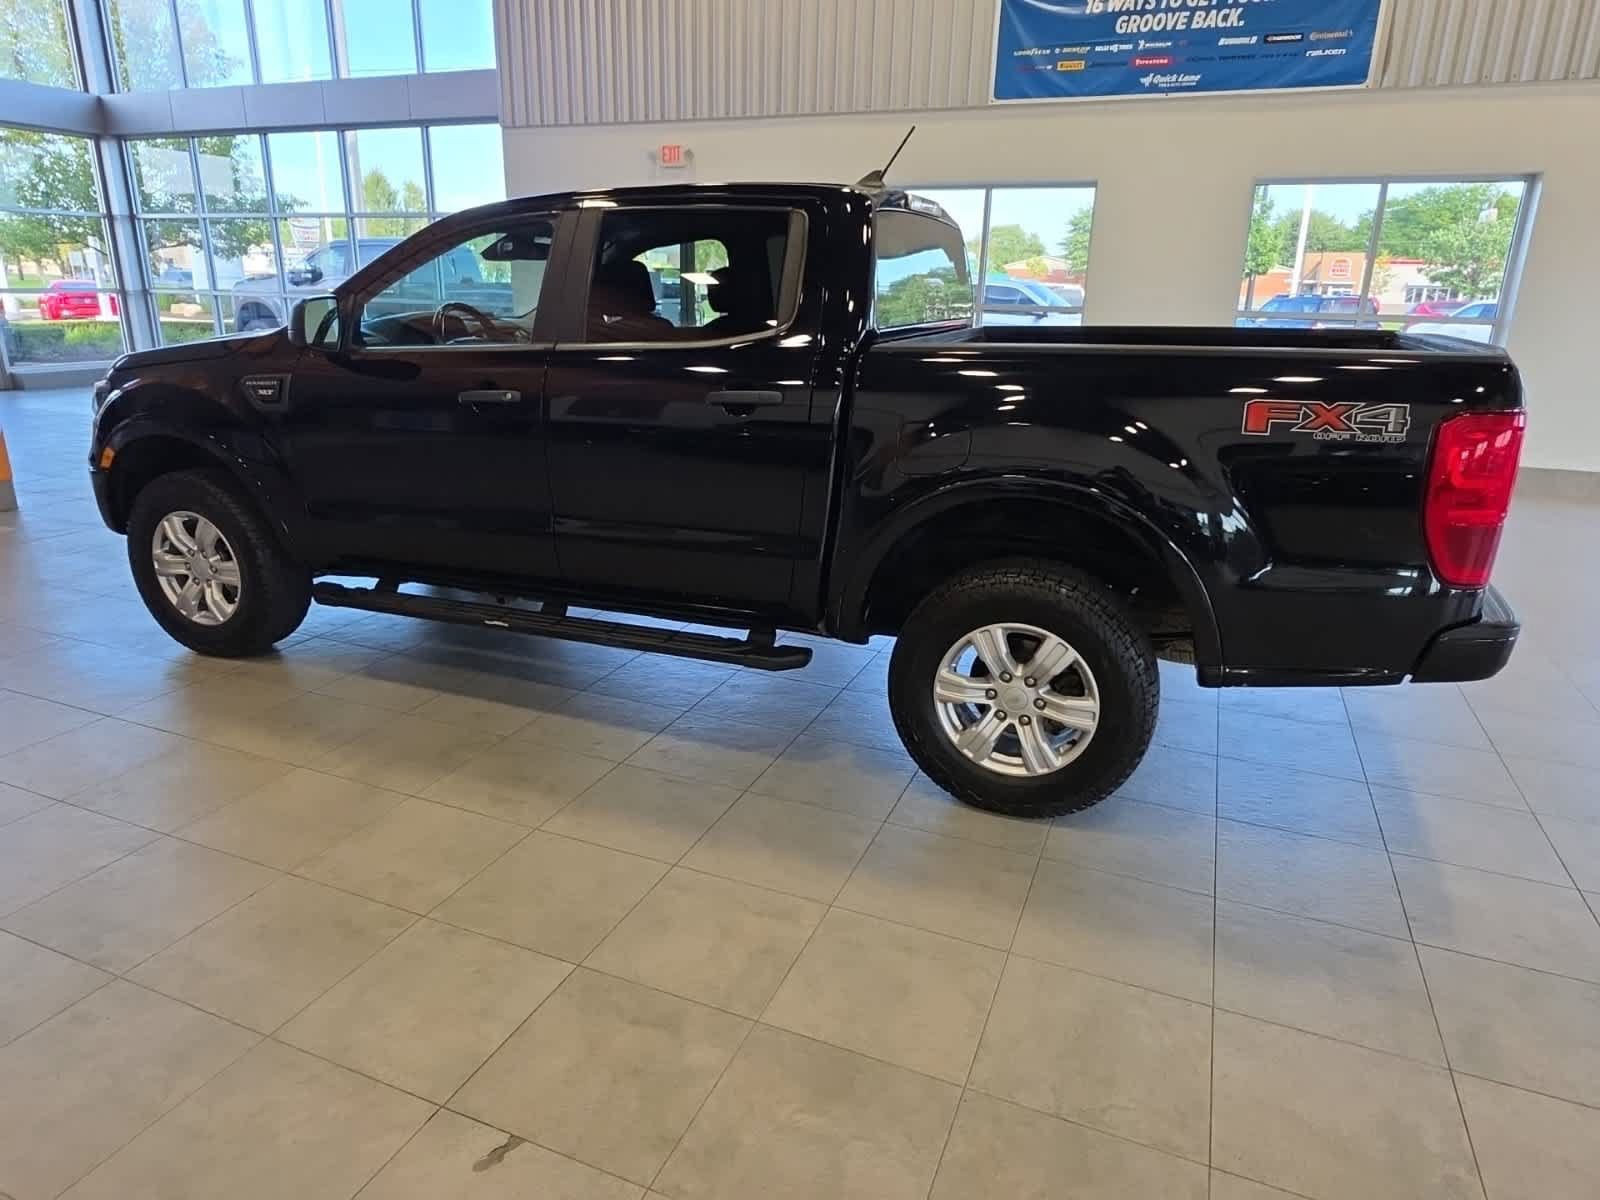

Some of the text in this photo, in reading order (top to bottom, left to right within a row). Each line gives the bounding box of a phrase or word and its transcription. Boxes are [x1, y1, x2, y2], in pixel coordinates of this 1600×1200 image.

[1115, 7, 1244, 33] GROOVE BACK.
[1241, 399, 1411, 435] FX4
